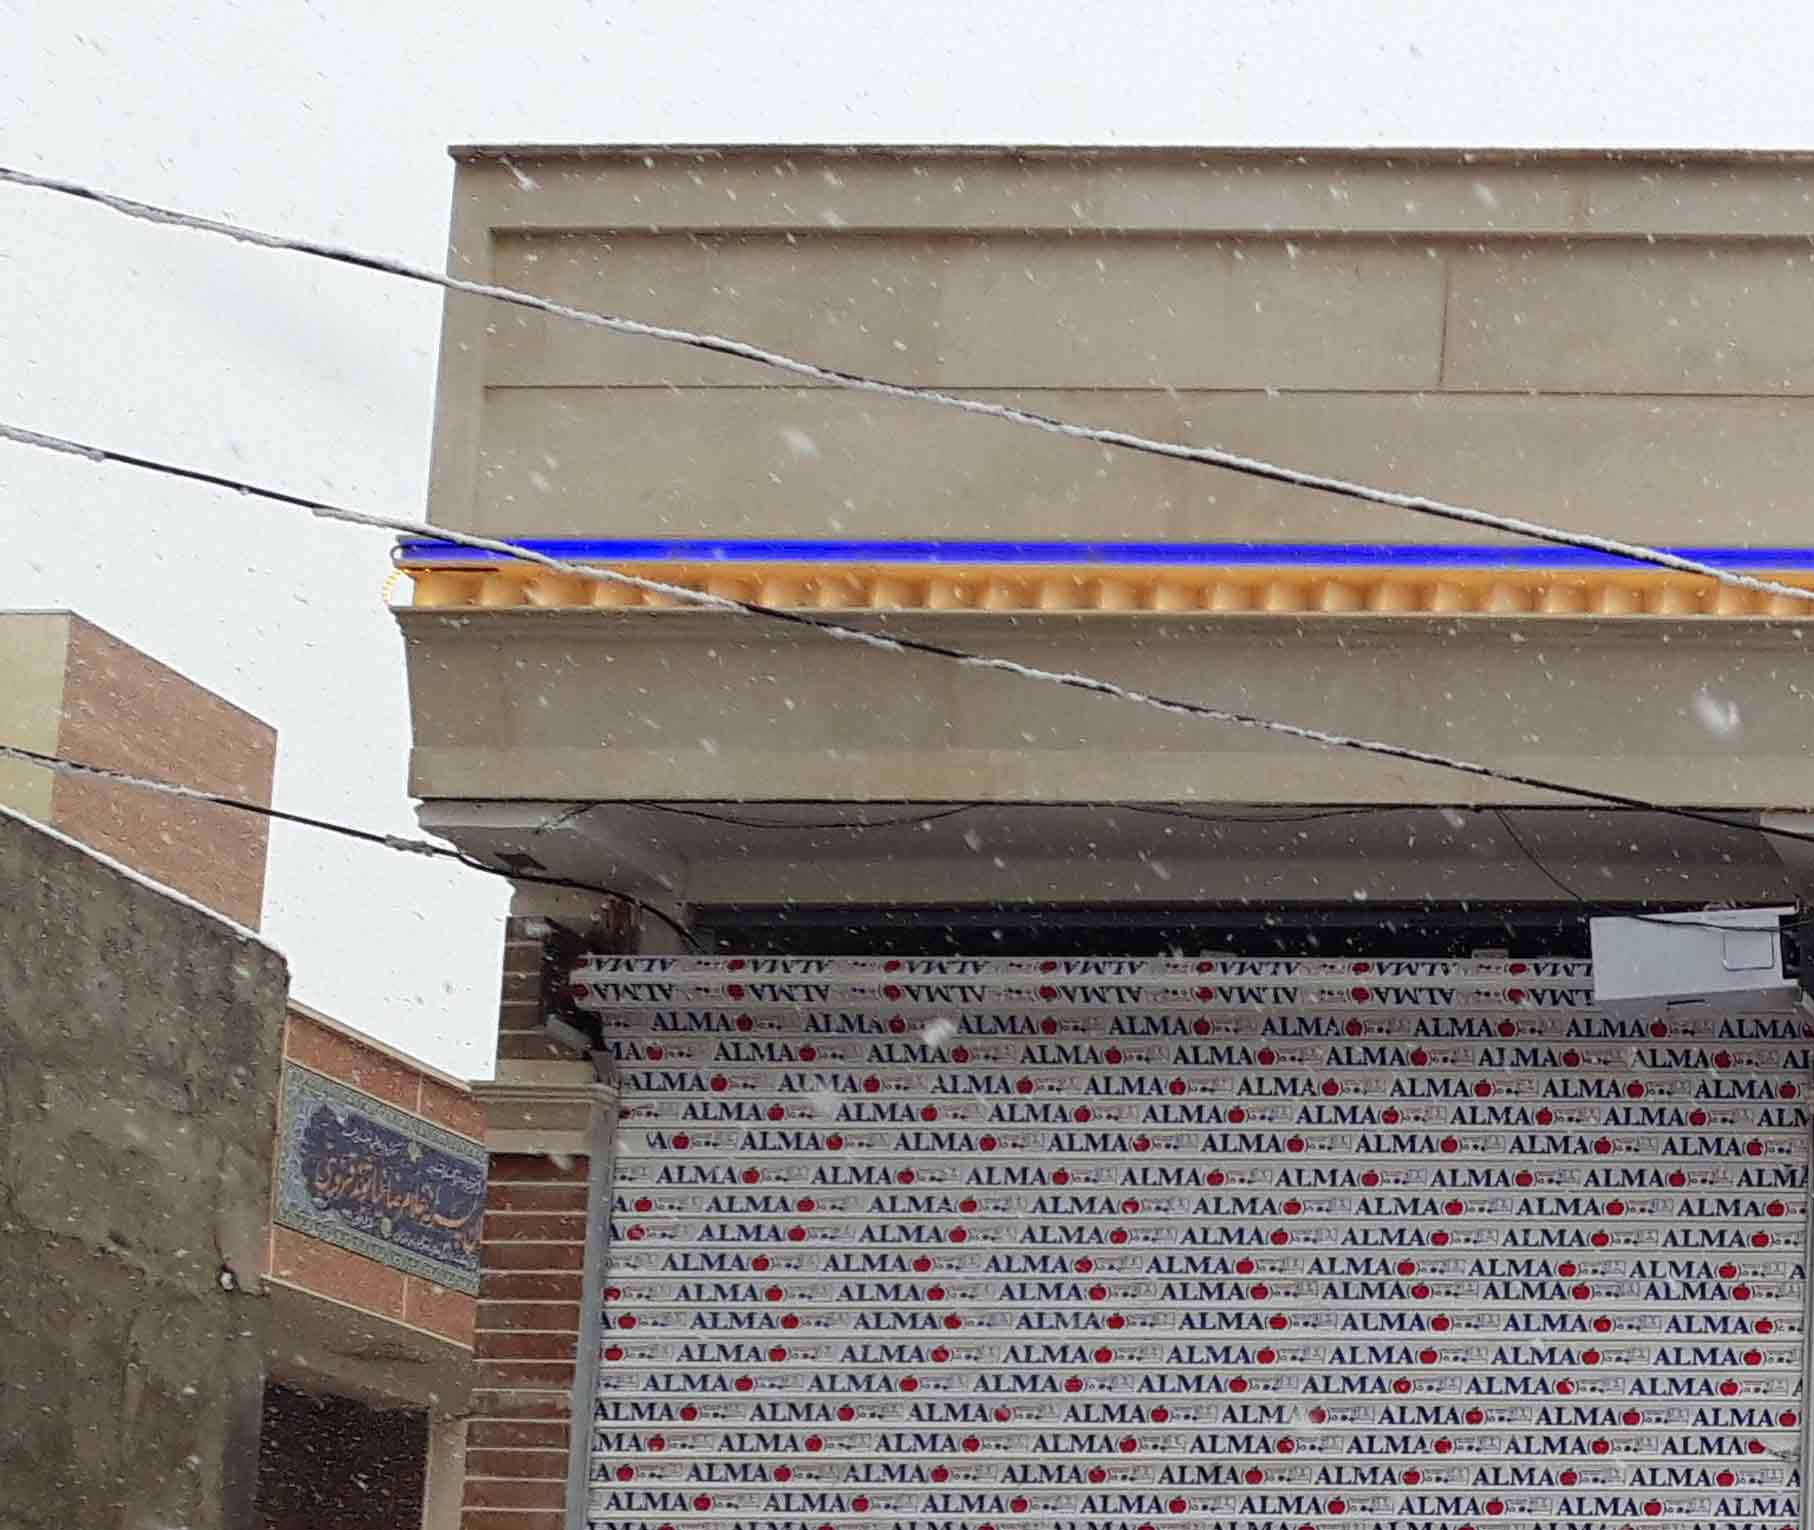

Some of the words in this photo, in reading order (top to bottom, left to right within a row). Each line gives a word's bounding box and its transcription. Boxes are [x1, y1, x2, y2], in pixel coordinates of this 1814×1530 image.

[715, 1041, 798, 1062] ALMA
[868, 1043, 951, 1064] ALMA
[1020, 1044, 1102, 1065] ALMA
[1172, 1045, 1253, 1065] ALMA
[1326, 1045, 1407, 1067] ALMA
[1477, 1047, 1559, 1068] ALMA
[689, 1311, 777, 1330] ALMA
[855, 1311, 939, 1330] ALMA
[1015, 1311, 1102, 1330] ALMA
[1178, 1311, 1265, 1330] ALMA
[1340, 1312, 1426, 1332] ALMA
[1503, 1313, 1588, 1333] ALMA
[1667, 1314, 1750, 1335] ALMA
